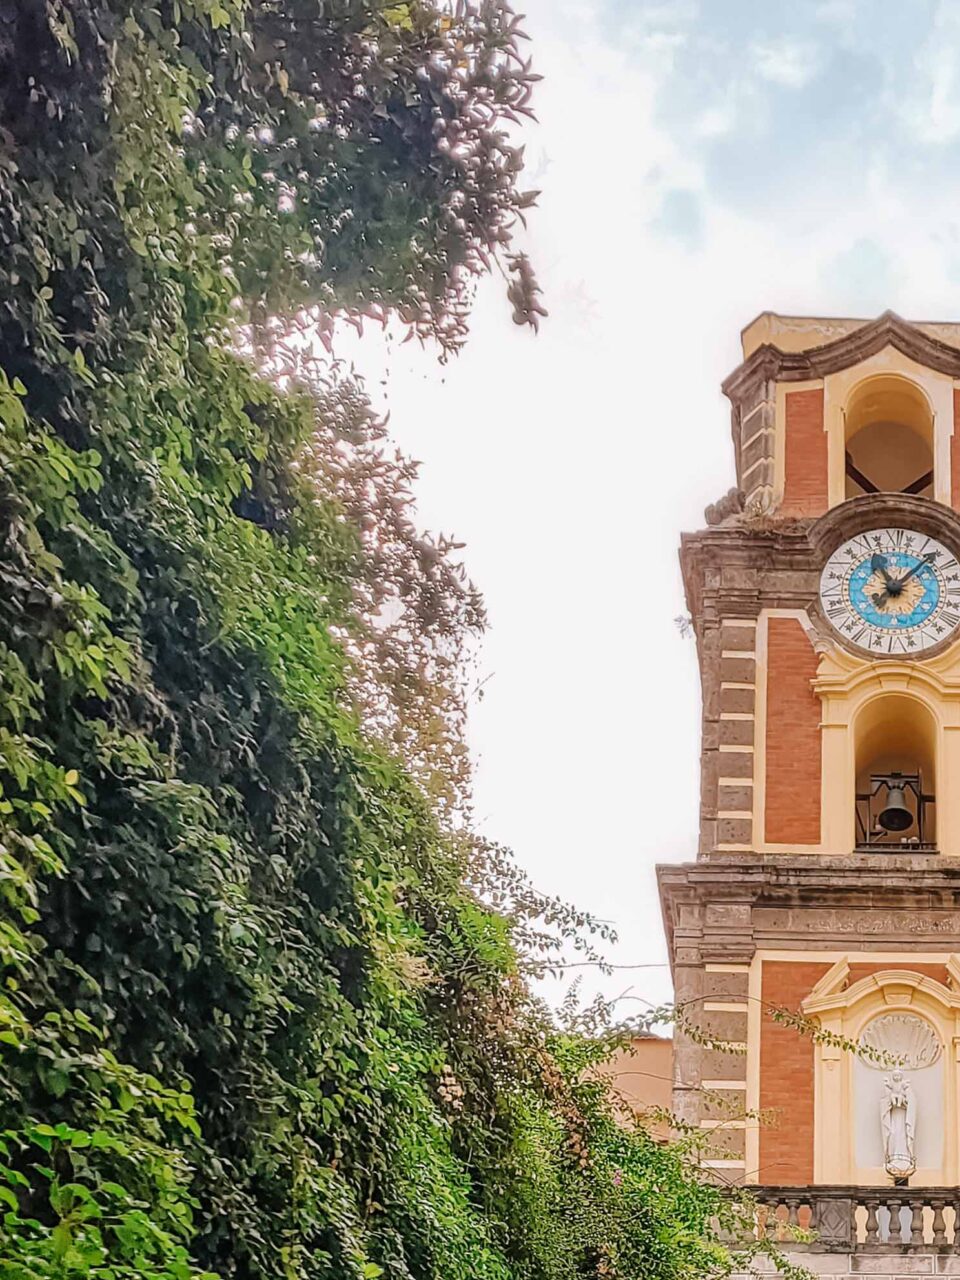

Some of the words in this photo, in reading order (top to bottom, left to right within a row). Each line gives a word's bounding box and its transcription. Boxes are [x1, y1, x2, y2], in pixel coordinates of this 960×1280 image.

[886, 530, 904, 547] XII
[920, 538, 931, 552] I
[939, 558, 957, 571] II
[939, 610, 960, 628] IIII
[888, 635, 907, 653] VI
